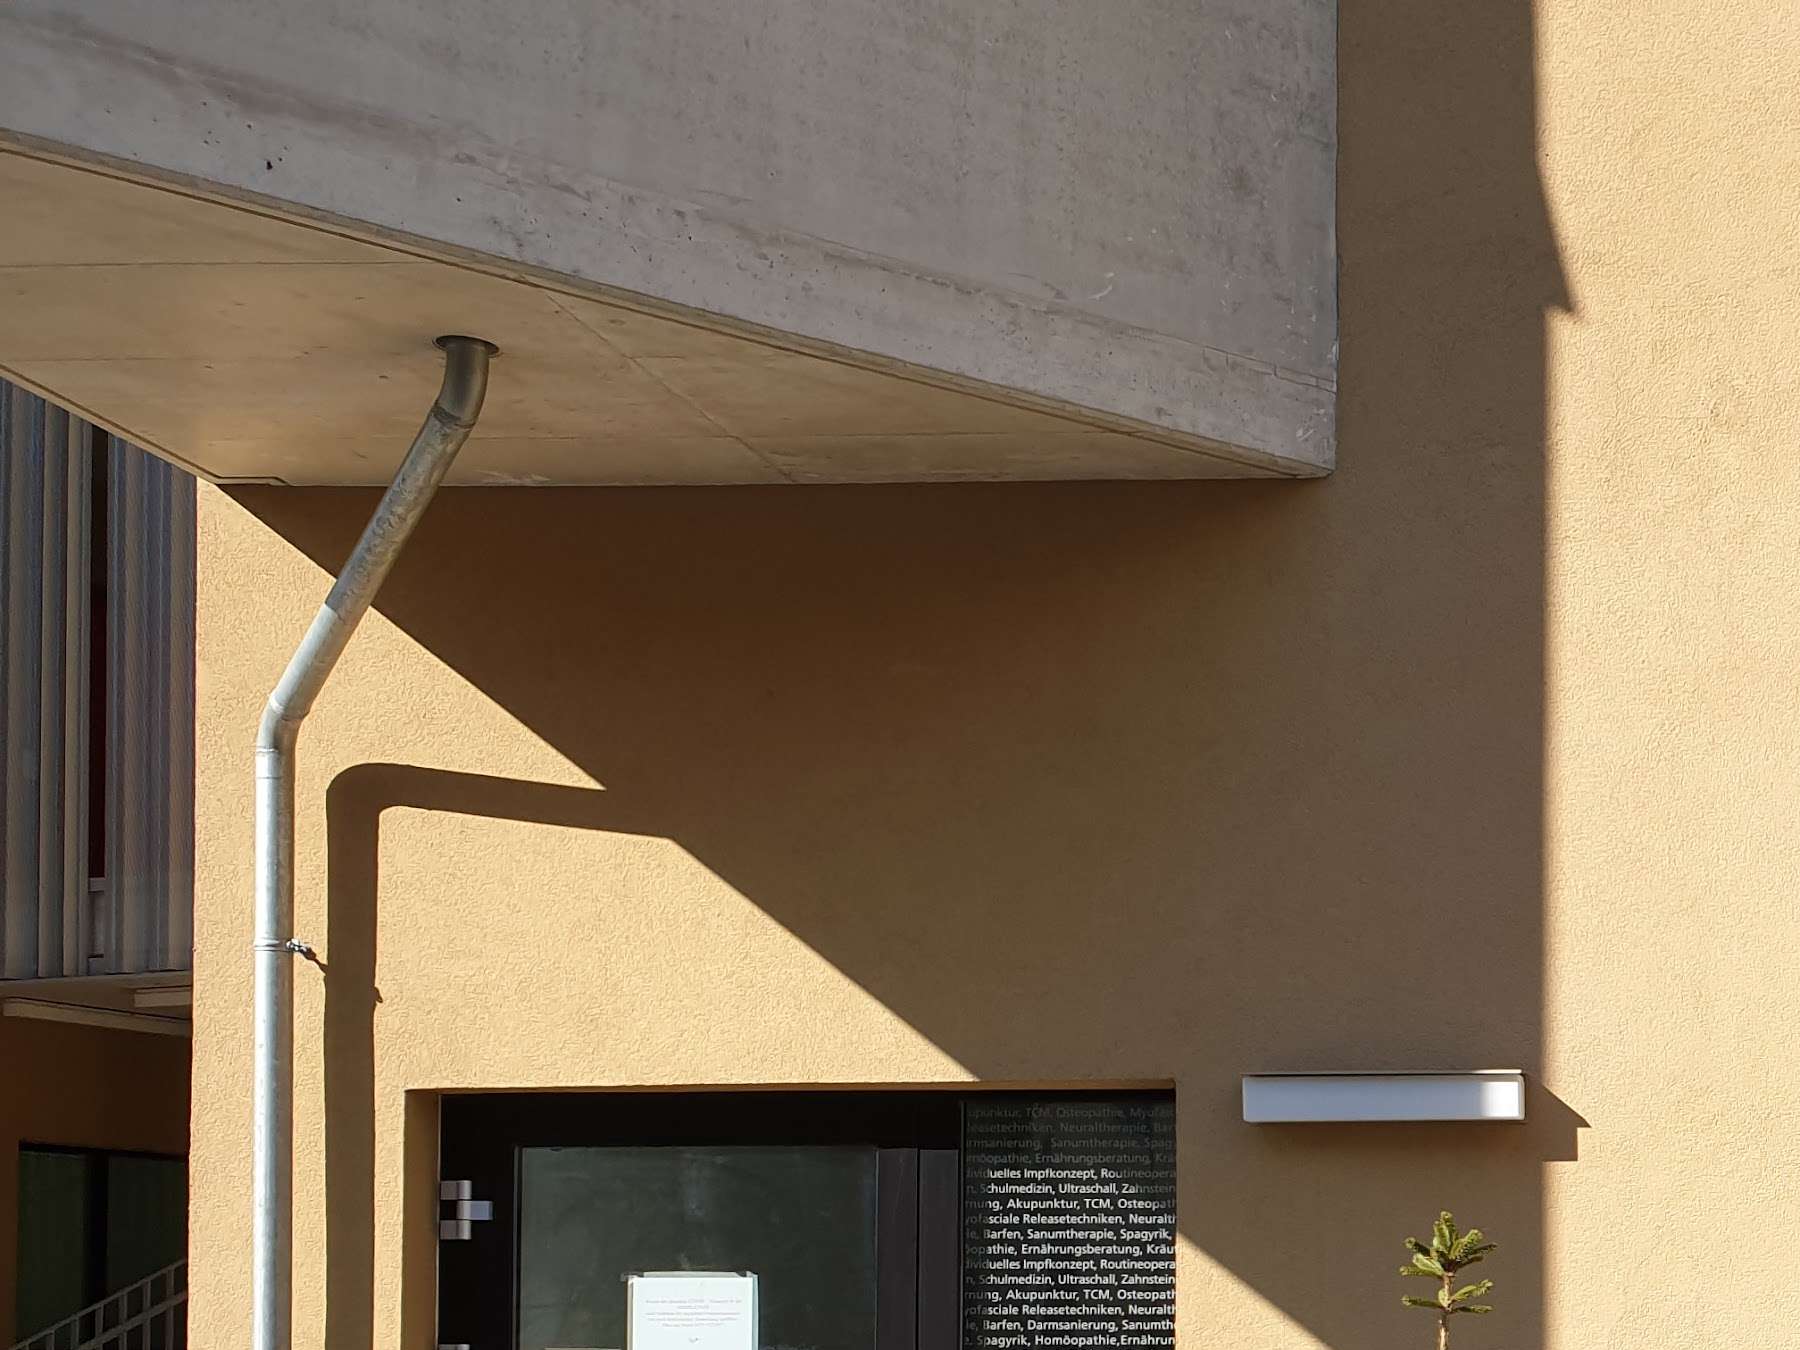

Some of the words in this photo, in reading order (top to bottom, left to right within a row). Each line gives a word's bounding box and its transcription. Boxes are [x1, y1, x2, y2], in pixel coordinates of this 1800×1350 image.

[1007, 1196, 1080, 1209] Akupunktur,
[1084, 1196, 1113, 1209] TCM,
[1023, 1212, 1125, 1225] Releasetechniken,
[1028, 1228, 1116, 1240] Sanumtherapie,
[1120, 1228, 1172, 1240] Spagyrik,
[1022, 1242, 1142, 1255] Ernährungsberatung,
[1058, 1272, 1117, 1285] Ultraschall,
